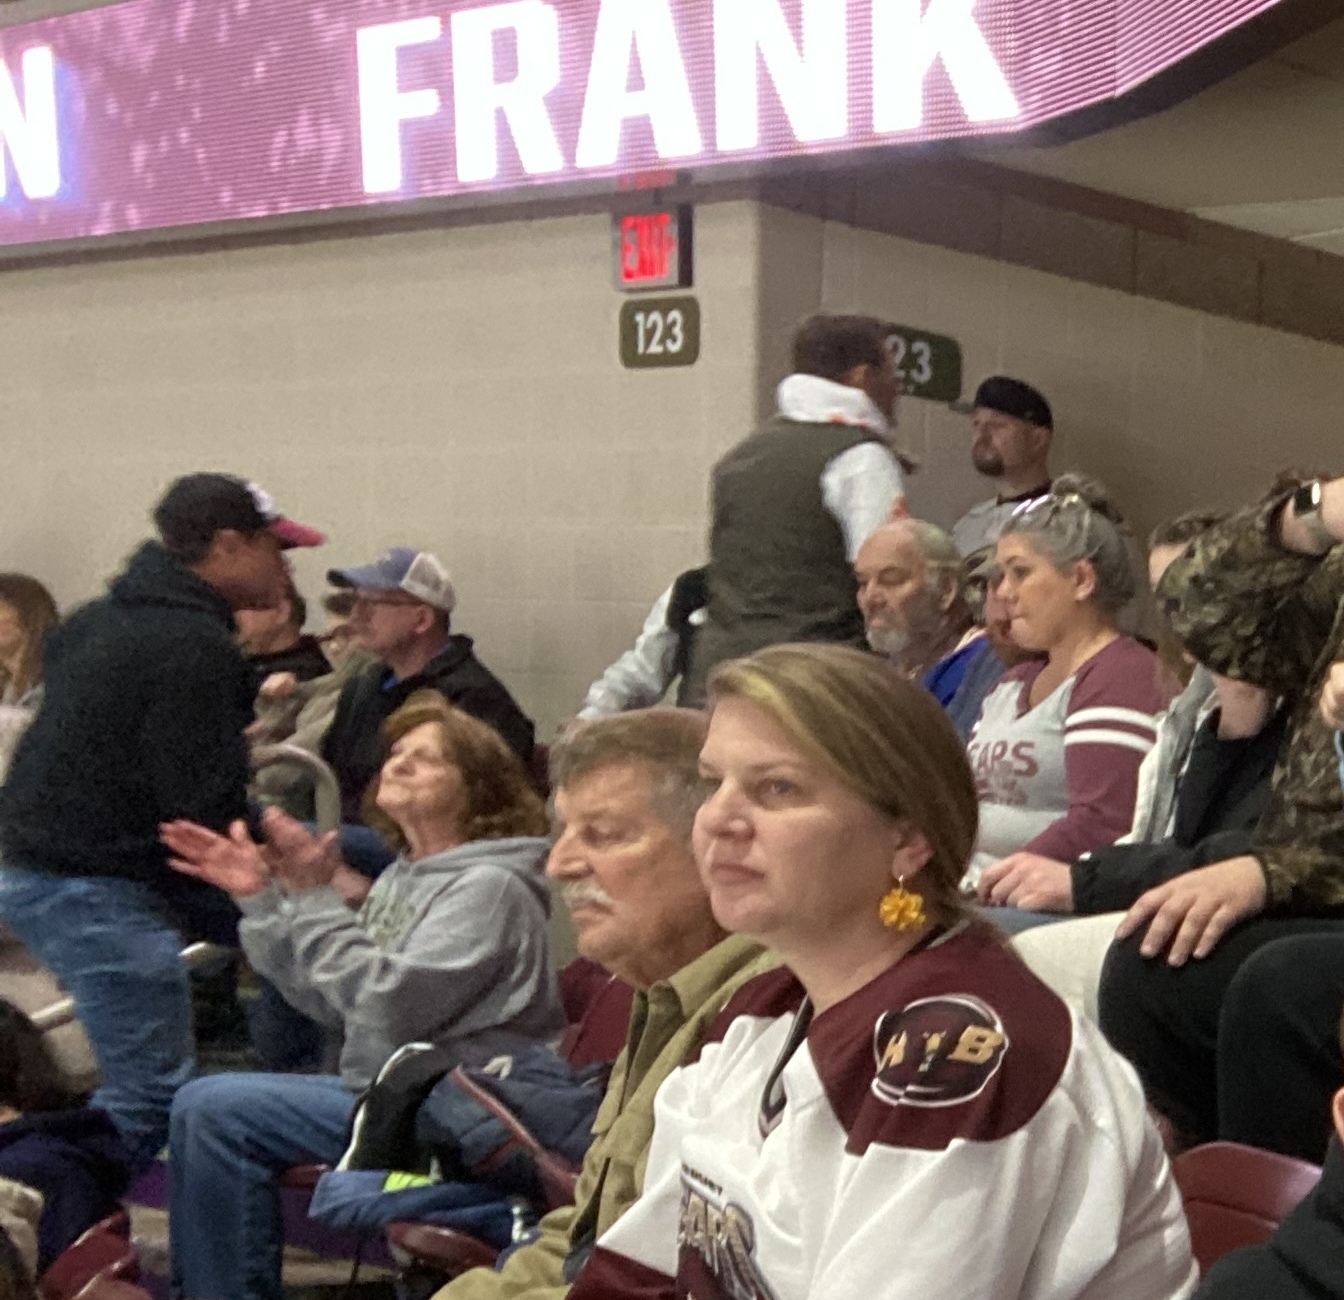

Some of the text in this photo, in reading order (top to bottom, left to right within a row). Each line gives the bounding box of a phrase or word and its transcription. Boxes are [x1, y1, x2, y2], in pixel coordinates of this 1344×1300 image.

[356, 0, 1021, 193] FRANK
[634, 310, 684, 355] 123
[884, 334, 932, 382] 23
